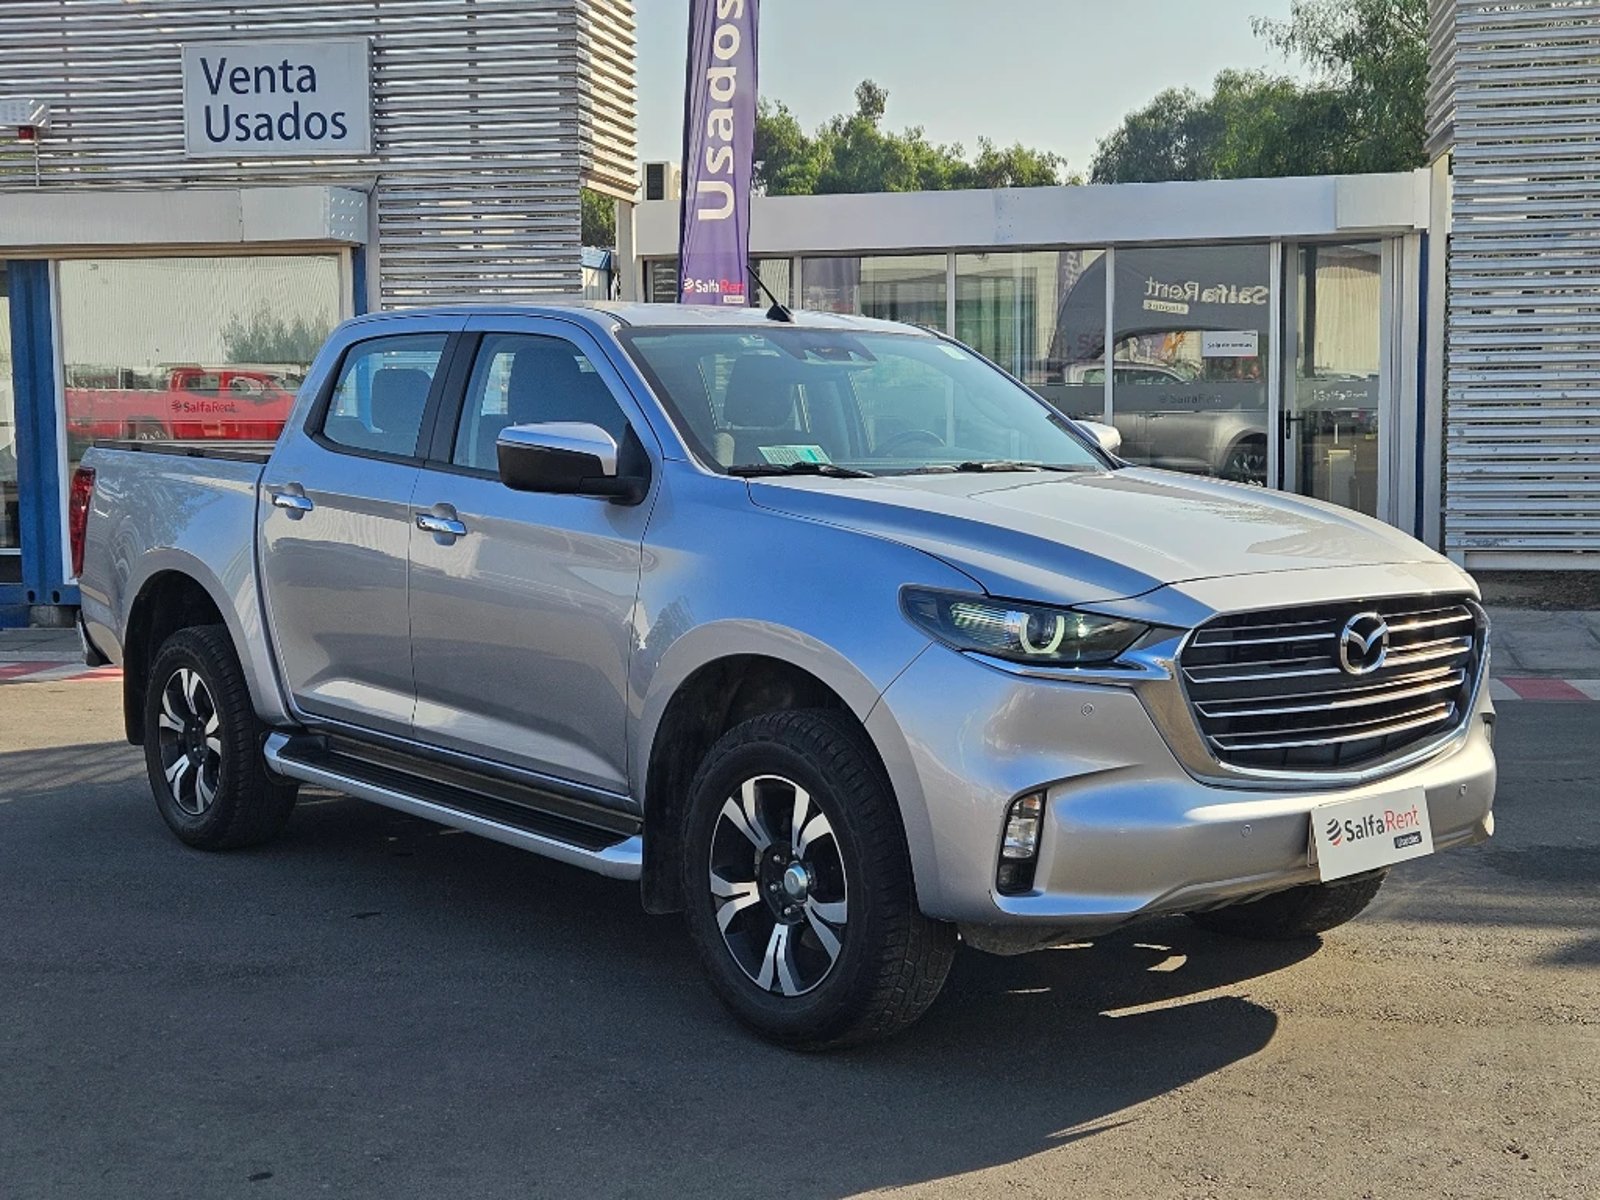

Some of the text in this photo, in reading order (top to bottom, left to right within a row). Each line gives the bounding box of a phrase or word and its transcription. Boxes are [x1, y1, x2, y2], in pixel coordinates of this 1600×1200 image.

[200, 57, 317, 95] Venta
[204, 101, 348, 143] Usados
[697, 0, 744, 220] Usados
[1344, 804, 1419, 842] SalfaRent
